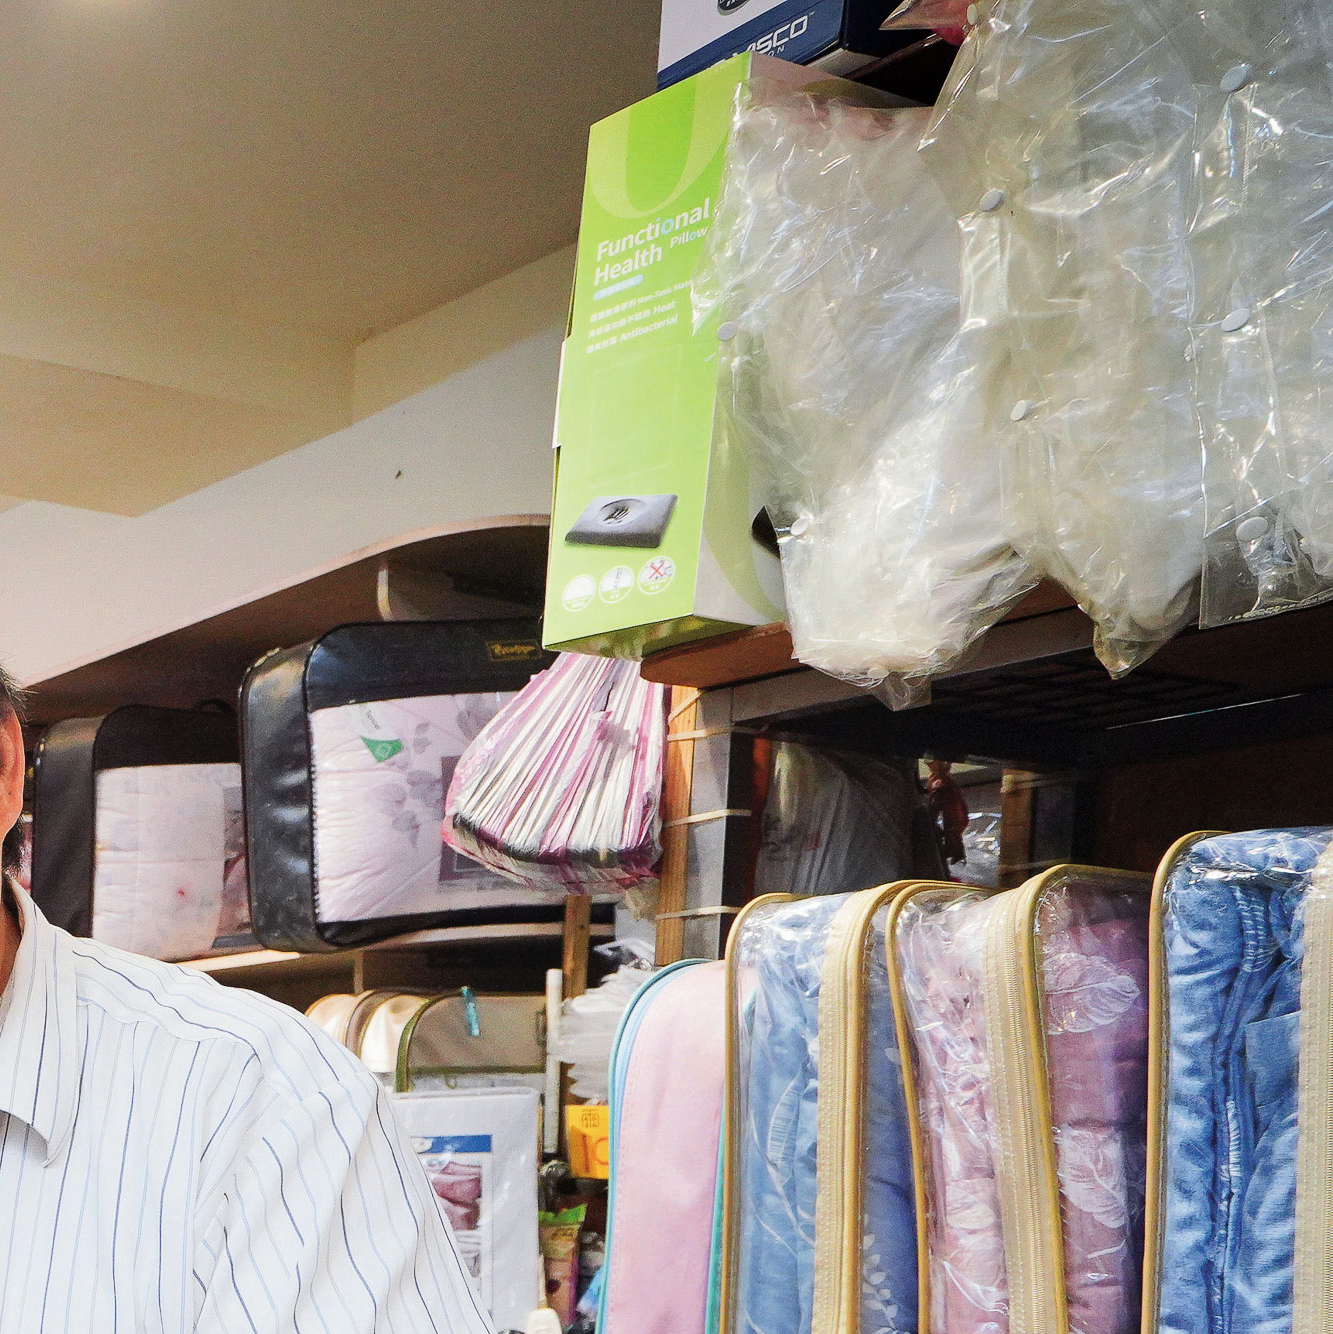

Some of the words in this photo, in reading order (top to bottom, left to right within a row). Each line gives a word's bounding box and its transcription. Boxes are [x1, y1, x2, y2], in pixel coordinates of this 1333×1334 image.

[747, 15, 809, 52] ASCO
[596, 197, 710, 263] Functional
[669, 225, 709, 249] Pillow
[593, 243, 663, 287] Health
